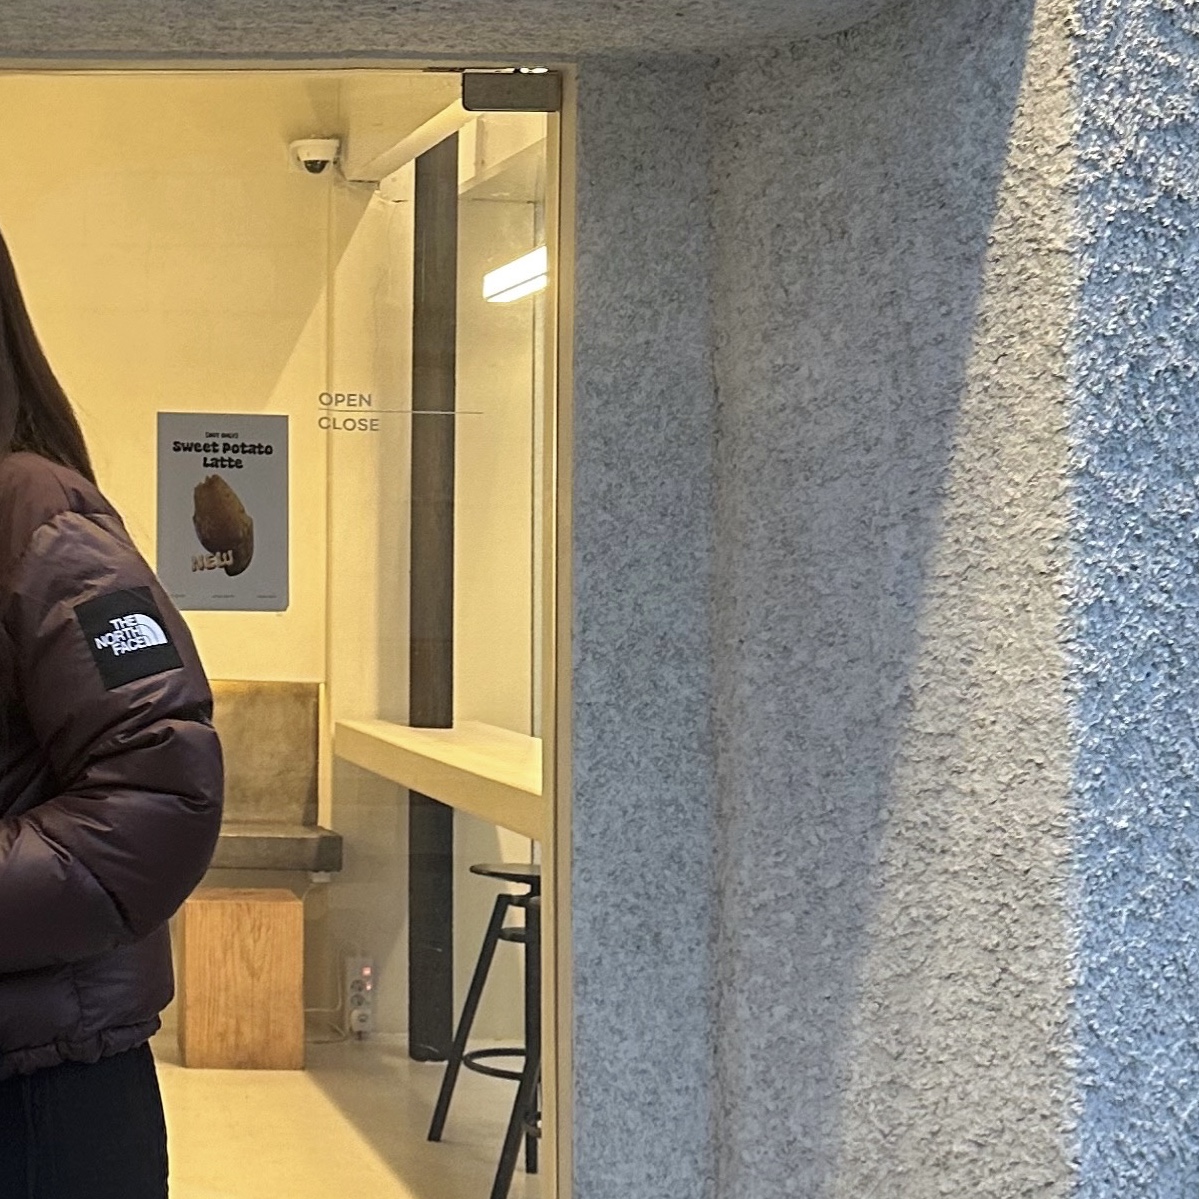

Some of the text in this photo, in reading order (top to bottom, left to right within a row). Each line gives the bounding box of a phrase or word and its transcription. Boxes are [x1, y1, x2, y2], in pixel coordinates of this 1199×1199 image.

[318, 392, 372, 407] OPEN
[318, 416, 380, 432] CLOSE
[173, 441, 273, 455] Sweet Potato
[203, 456, 244, 469] Latte
[191, 549, 234, 573] NEW
[109, 614, 138, 630] THE
[94, 625, 143, 650] NORTH
[112, 636, 147, 656] FACE
